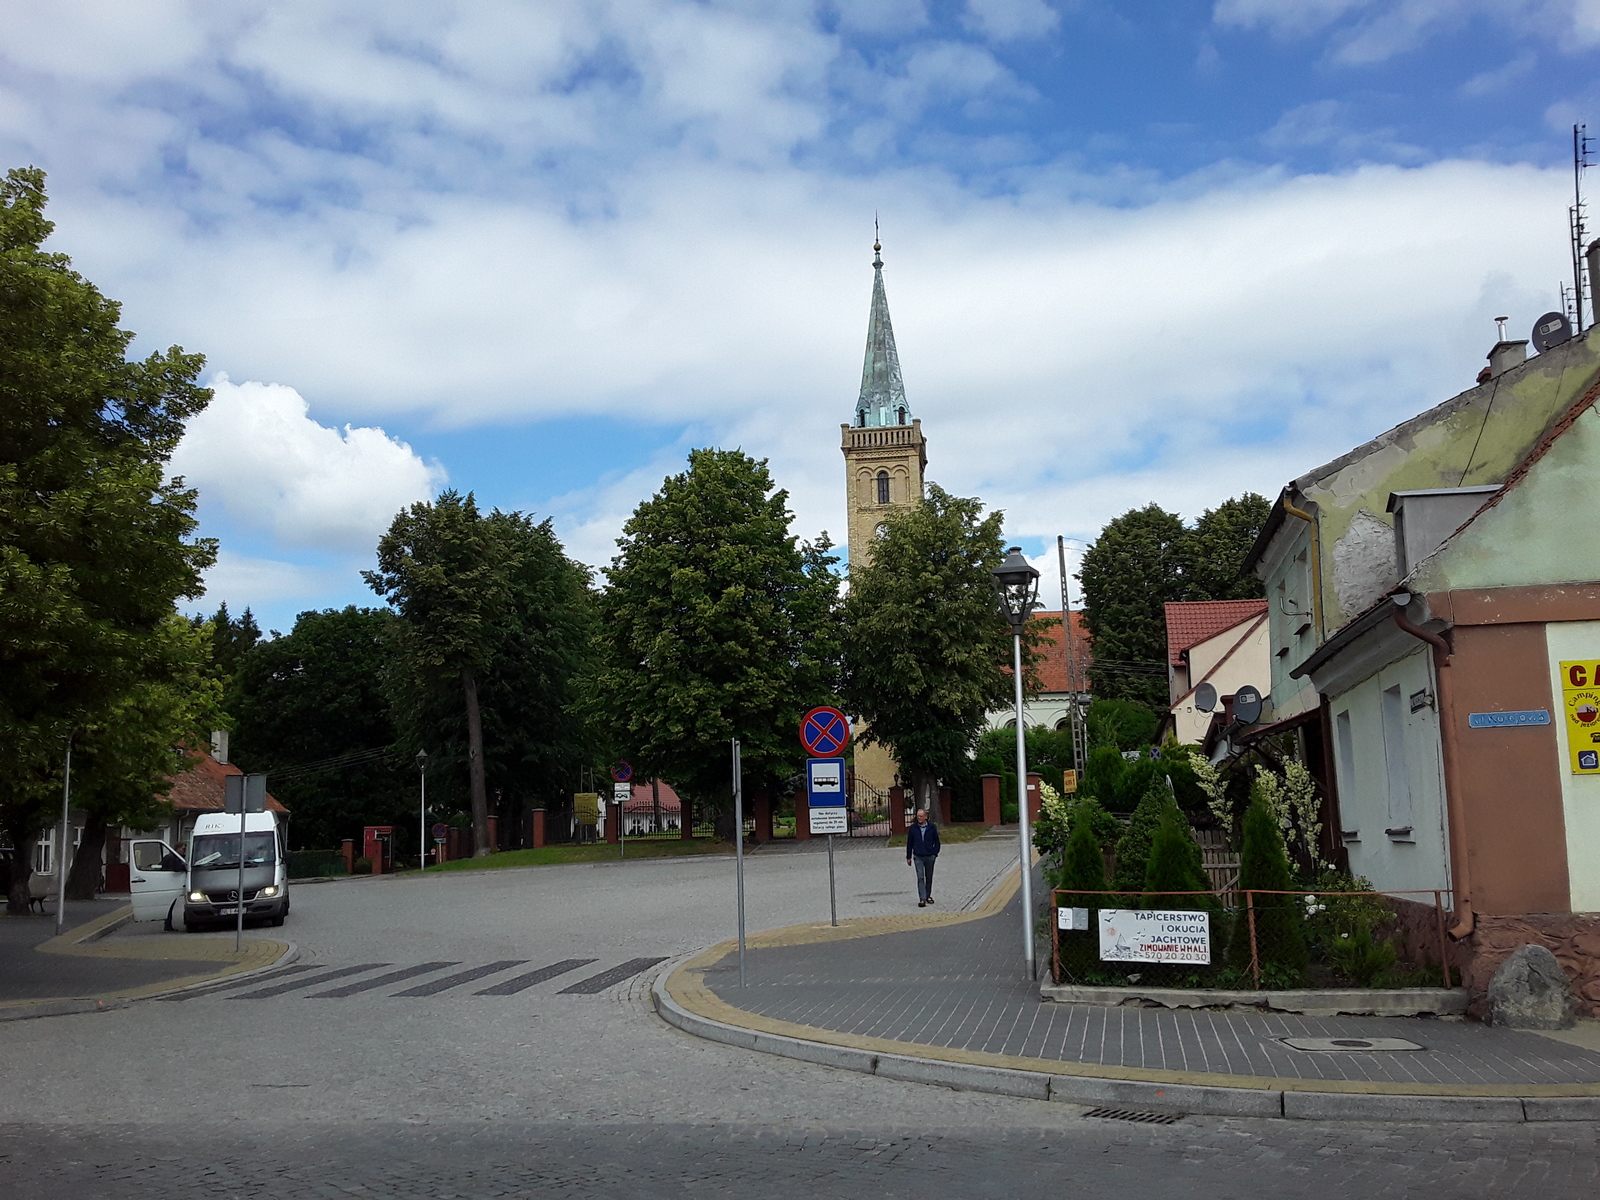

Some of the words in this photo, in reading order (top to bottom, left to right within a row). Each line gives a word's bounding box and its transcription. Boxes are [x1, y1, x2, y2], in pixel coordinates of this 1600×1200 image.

[1134, 912, 1206, 922] TAPICERSTWO
[1167, 925, 1206, 933] OKUCIA
[1150, 935, 1207, 944] JACHTOWE
[1139, 944, 1179, 952] ZIMOWANIE
[1145, 952, 1163, 960] 570
[1165, 952, 1177, 960] 20
[1180, 953, 1192, 961] 20
[1195, 953, 1207, 961] 30
